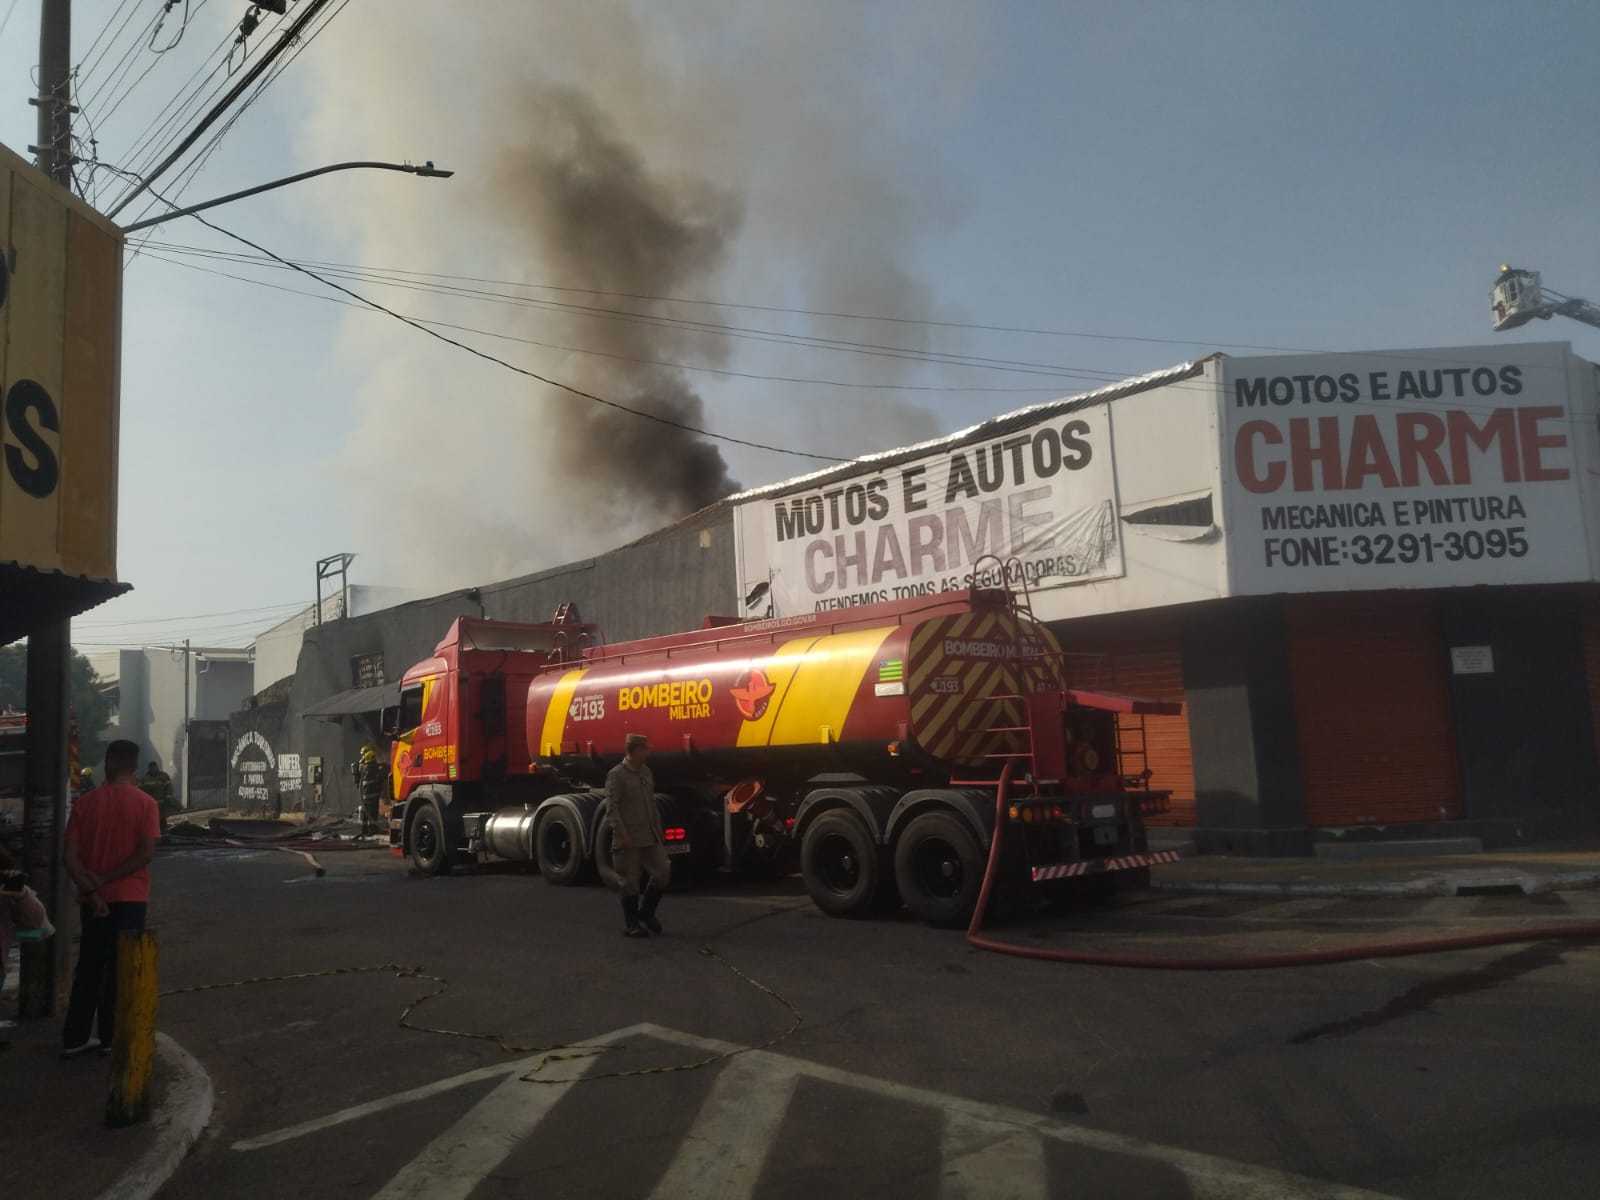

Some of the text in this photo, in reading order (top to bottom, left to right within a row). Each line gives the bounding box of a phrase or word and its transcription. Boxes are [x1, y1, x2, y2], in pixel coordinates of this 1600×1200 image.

[1235, 365, 1524, 407] MOTOS E AUTOS
[0, 378, 60, 499] S
[1234, 405, 1571, 494] CHARME
[774, 419, 1093, 542] MOTOS E AUTOS
[1261, 495, 1527, 530] MECANICA E PINTURA
[804, 485, 1056, 595] CHARME
[814, 554, 1077, 613] ATENDEMOS TODAS AS SEGURADORAS
[944, 640, 1005, 658] BOMBEIRO
[619, 678, 713, 711] BOMBEIRO
[943, 680, 960, 693] 193
[582, 699, 605, 721] 193
[669, 702, 711, 721] MILITAR
